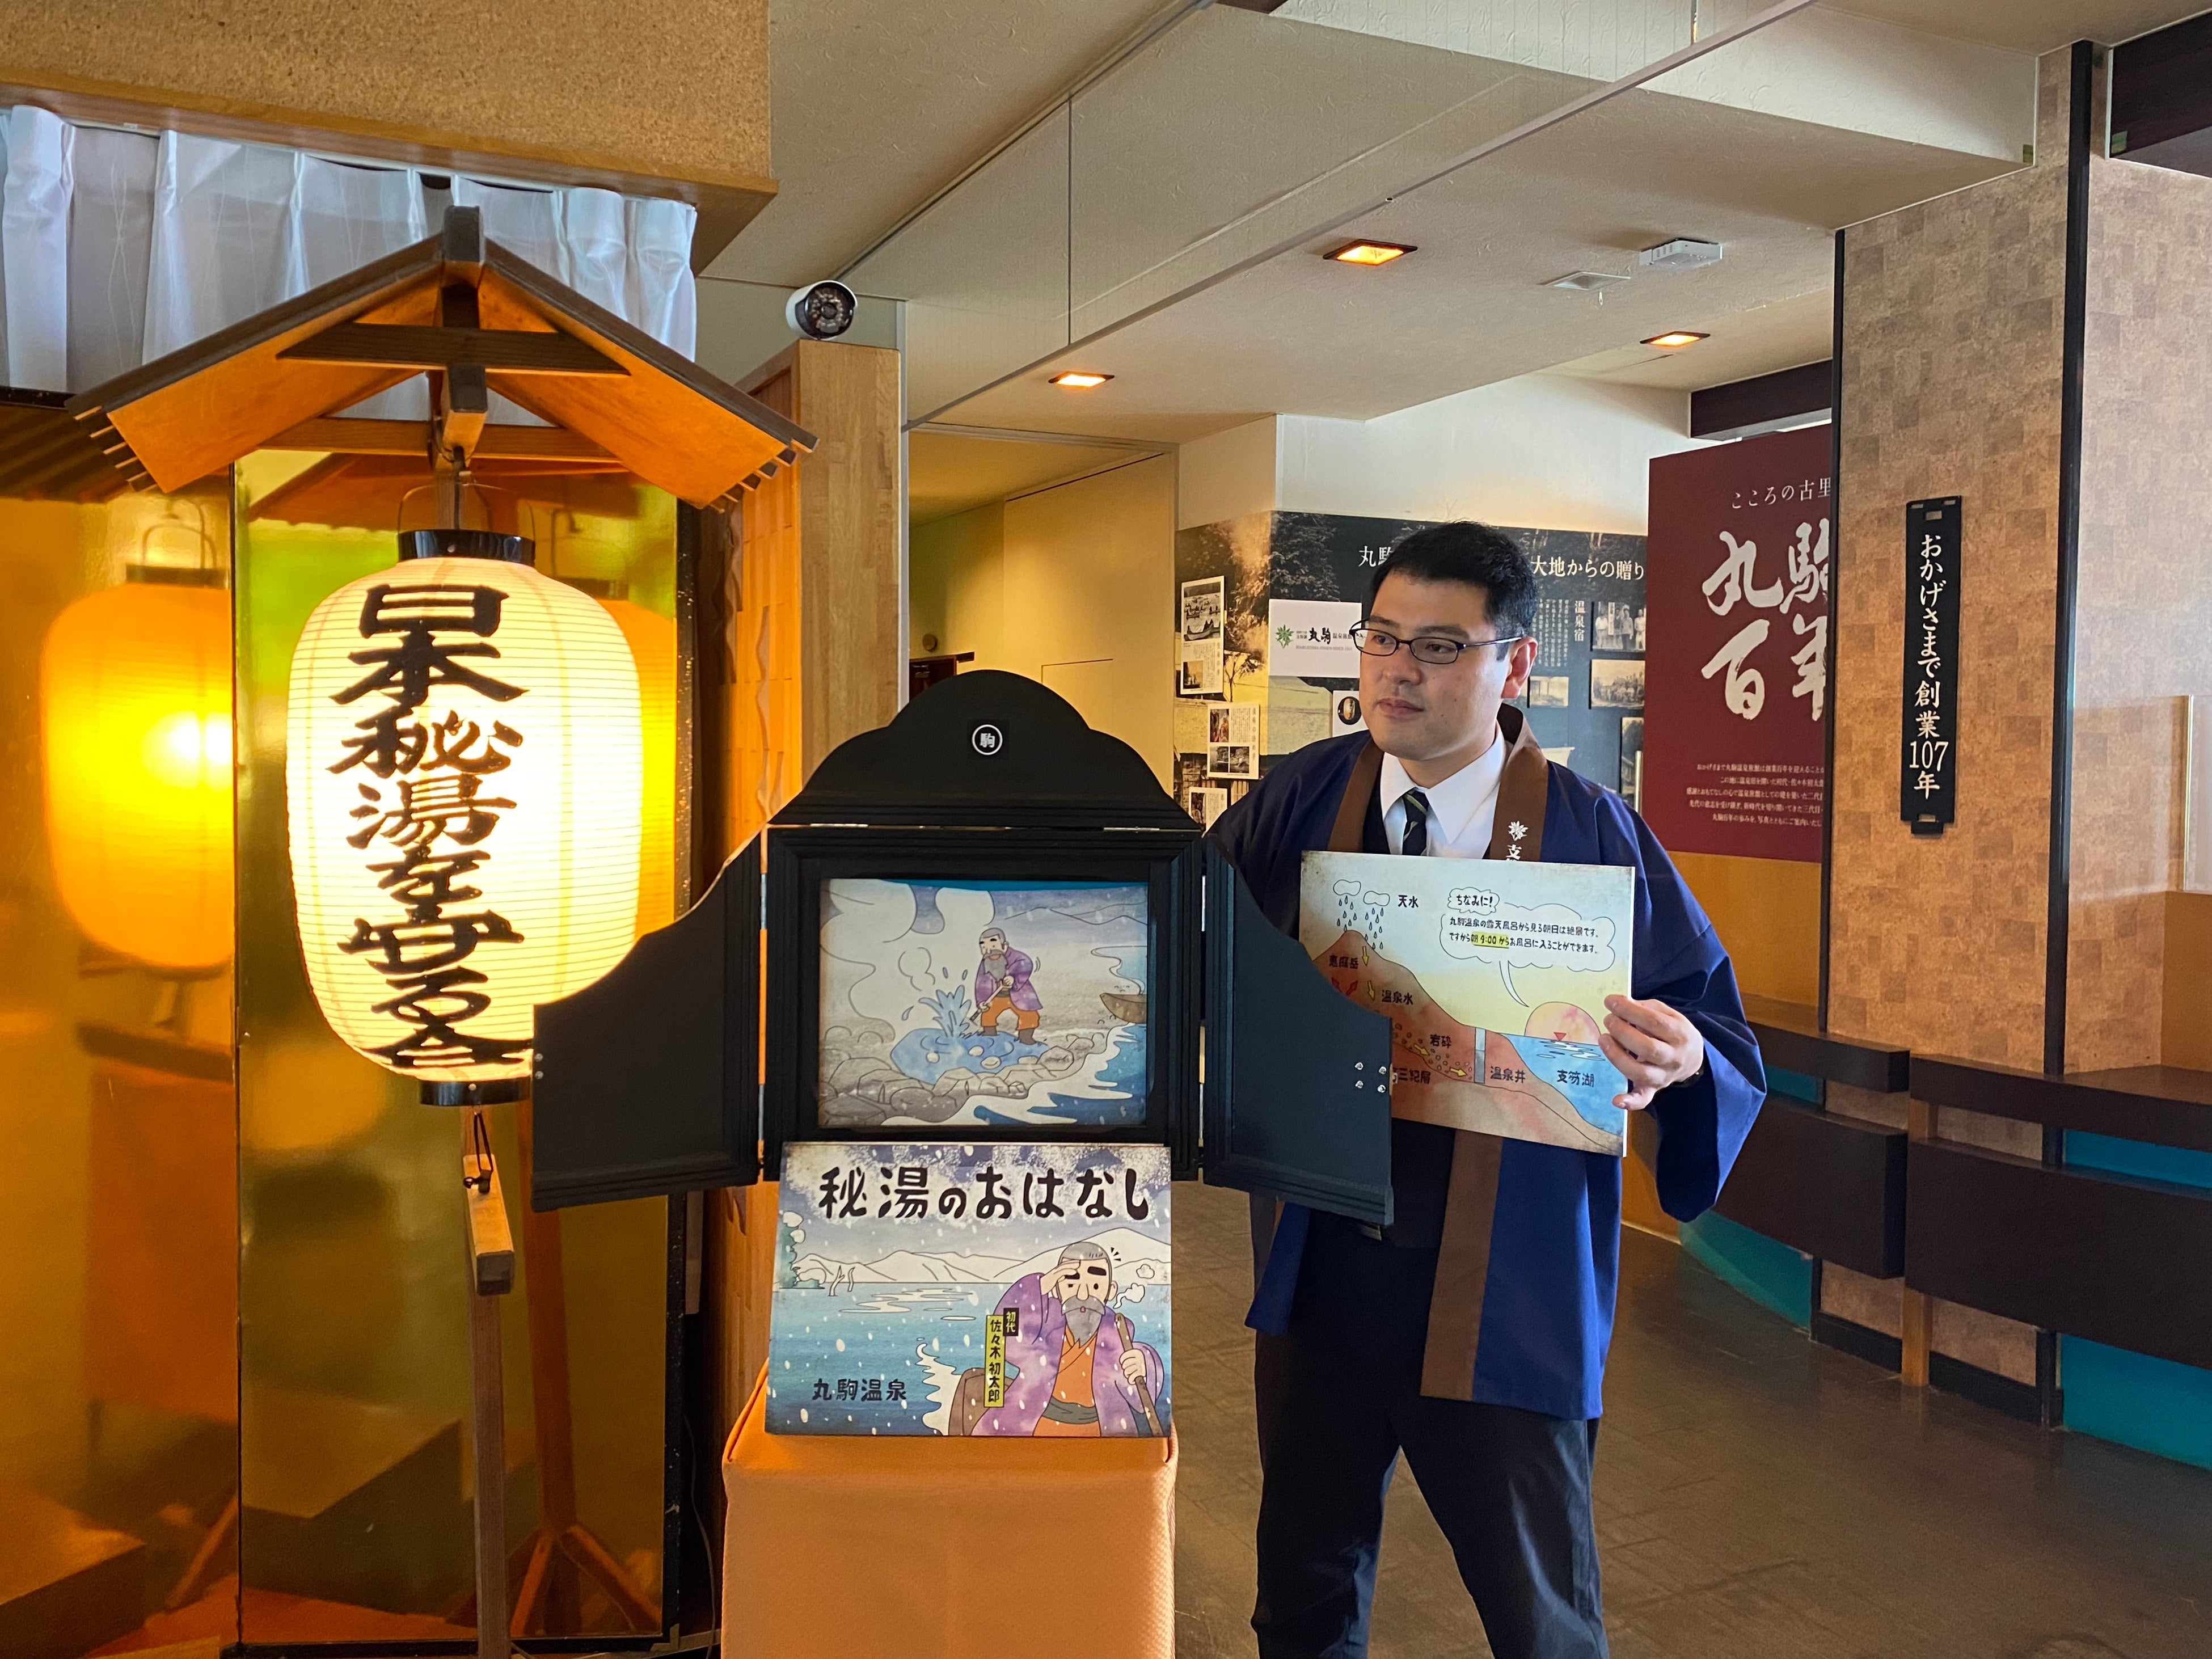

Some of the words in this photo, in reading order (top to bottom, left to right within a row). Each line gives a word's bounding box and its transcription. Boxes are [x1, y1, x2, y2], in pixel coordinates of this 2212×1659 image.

[1732, 477, 1831, 509] こころの古里
[1531, 555, 1644, 580] 大地からの贈り
[1574, 600, 1585, 641] 温泉宿
[1910, 534, 1948, 799] おかげさまで創業107年
[1398, 894, 1419, 909] 天水
[1382, 990, 1413, 1004] 温泉水
[1491, 1066, 1526, 1083] 温泉井
[1557, 1070, 1594, 1087] 支笏湖
[818, 1166, 1149, 1220] 秘湯のおはなし
[1006, 1311, 1016, 1333] 初代
[989, 1320, 1002, 1402] 佐々木初太郎
[813, 1378, 907, 1402] 丸駒温泉
